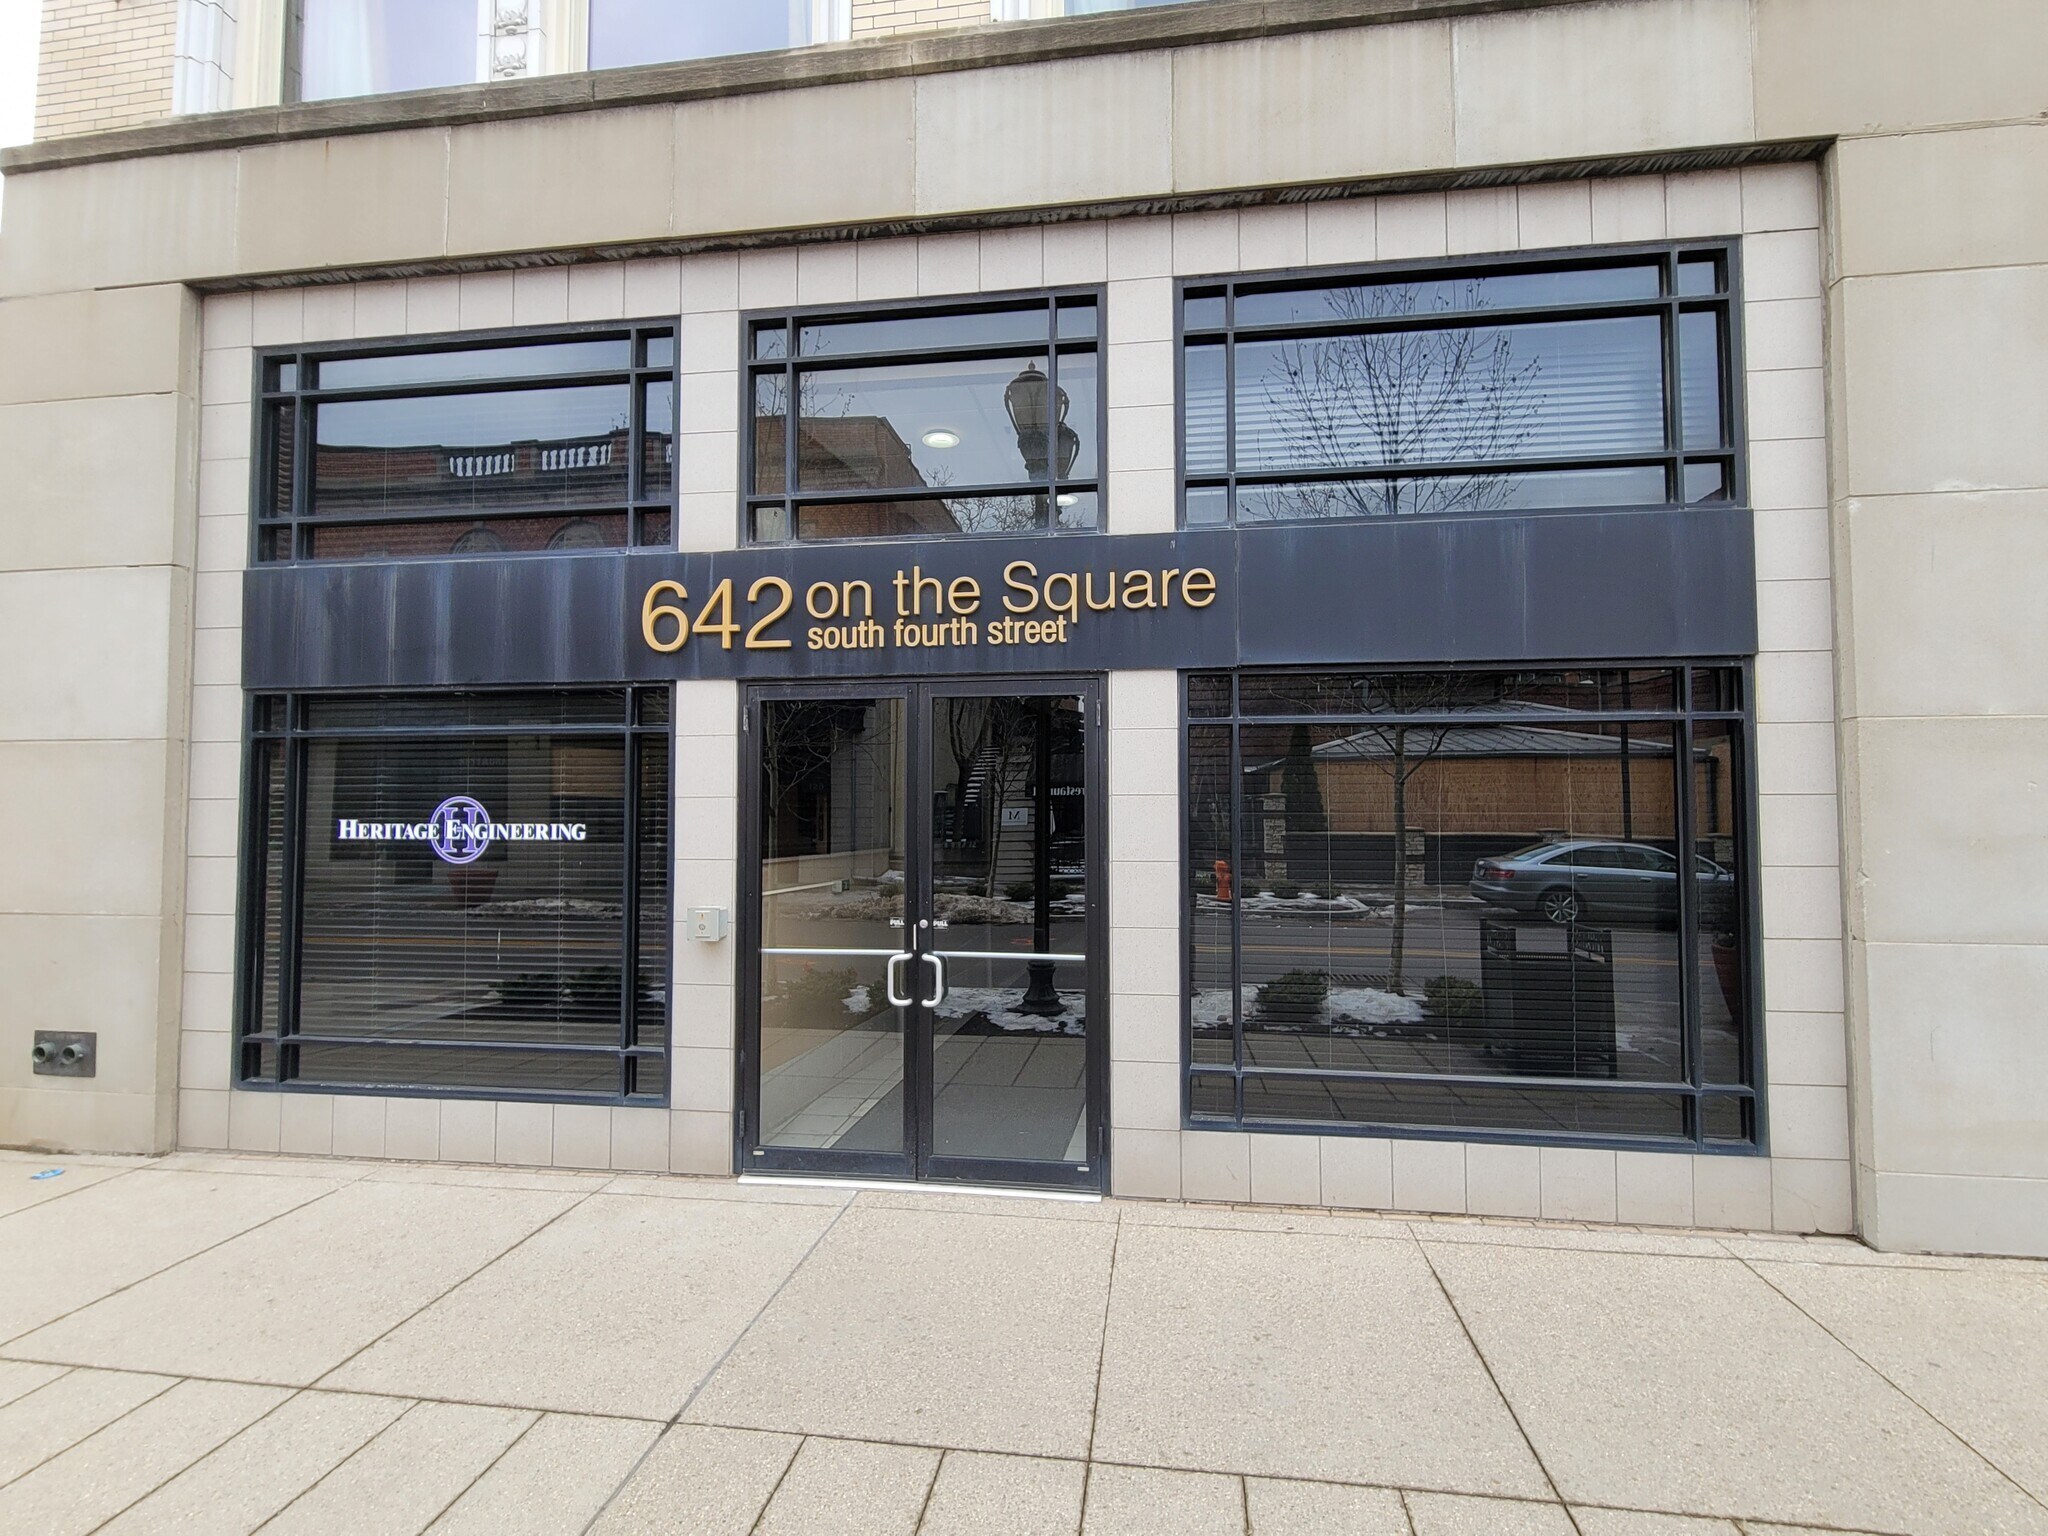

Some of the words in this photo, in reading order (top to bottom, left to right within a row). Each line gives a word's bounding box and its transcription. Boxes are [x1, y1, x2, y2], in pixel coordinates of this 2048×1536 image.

[641, 576, 793, 653] 642
[805, 580, 872, 619] on
[892, 565, 981, 616] the
[1002, 560, 1217, 624] Square
[807, 619, 885, 650] south
[893, 616, 978, 648] fourth
[987, 615, 1067, 645] street
[338, 819, 440, 840] HERITAGE
[445, 819, 587, 840] ENGINEERING
